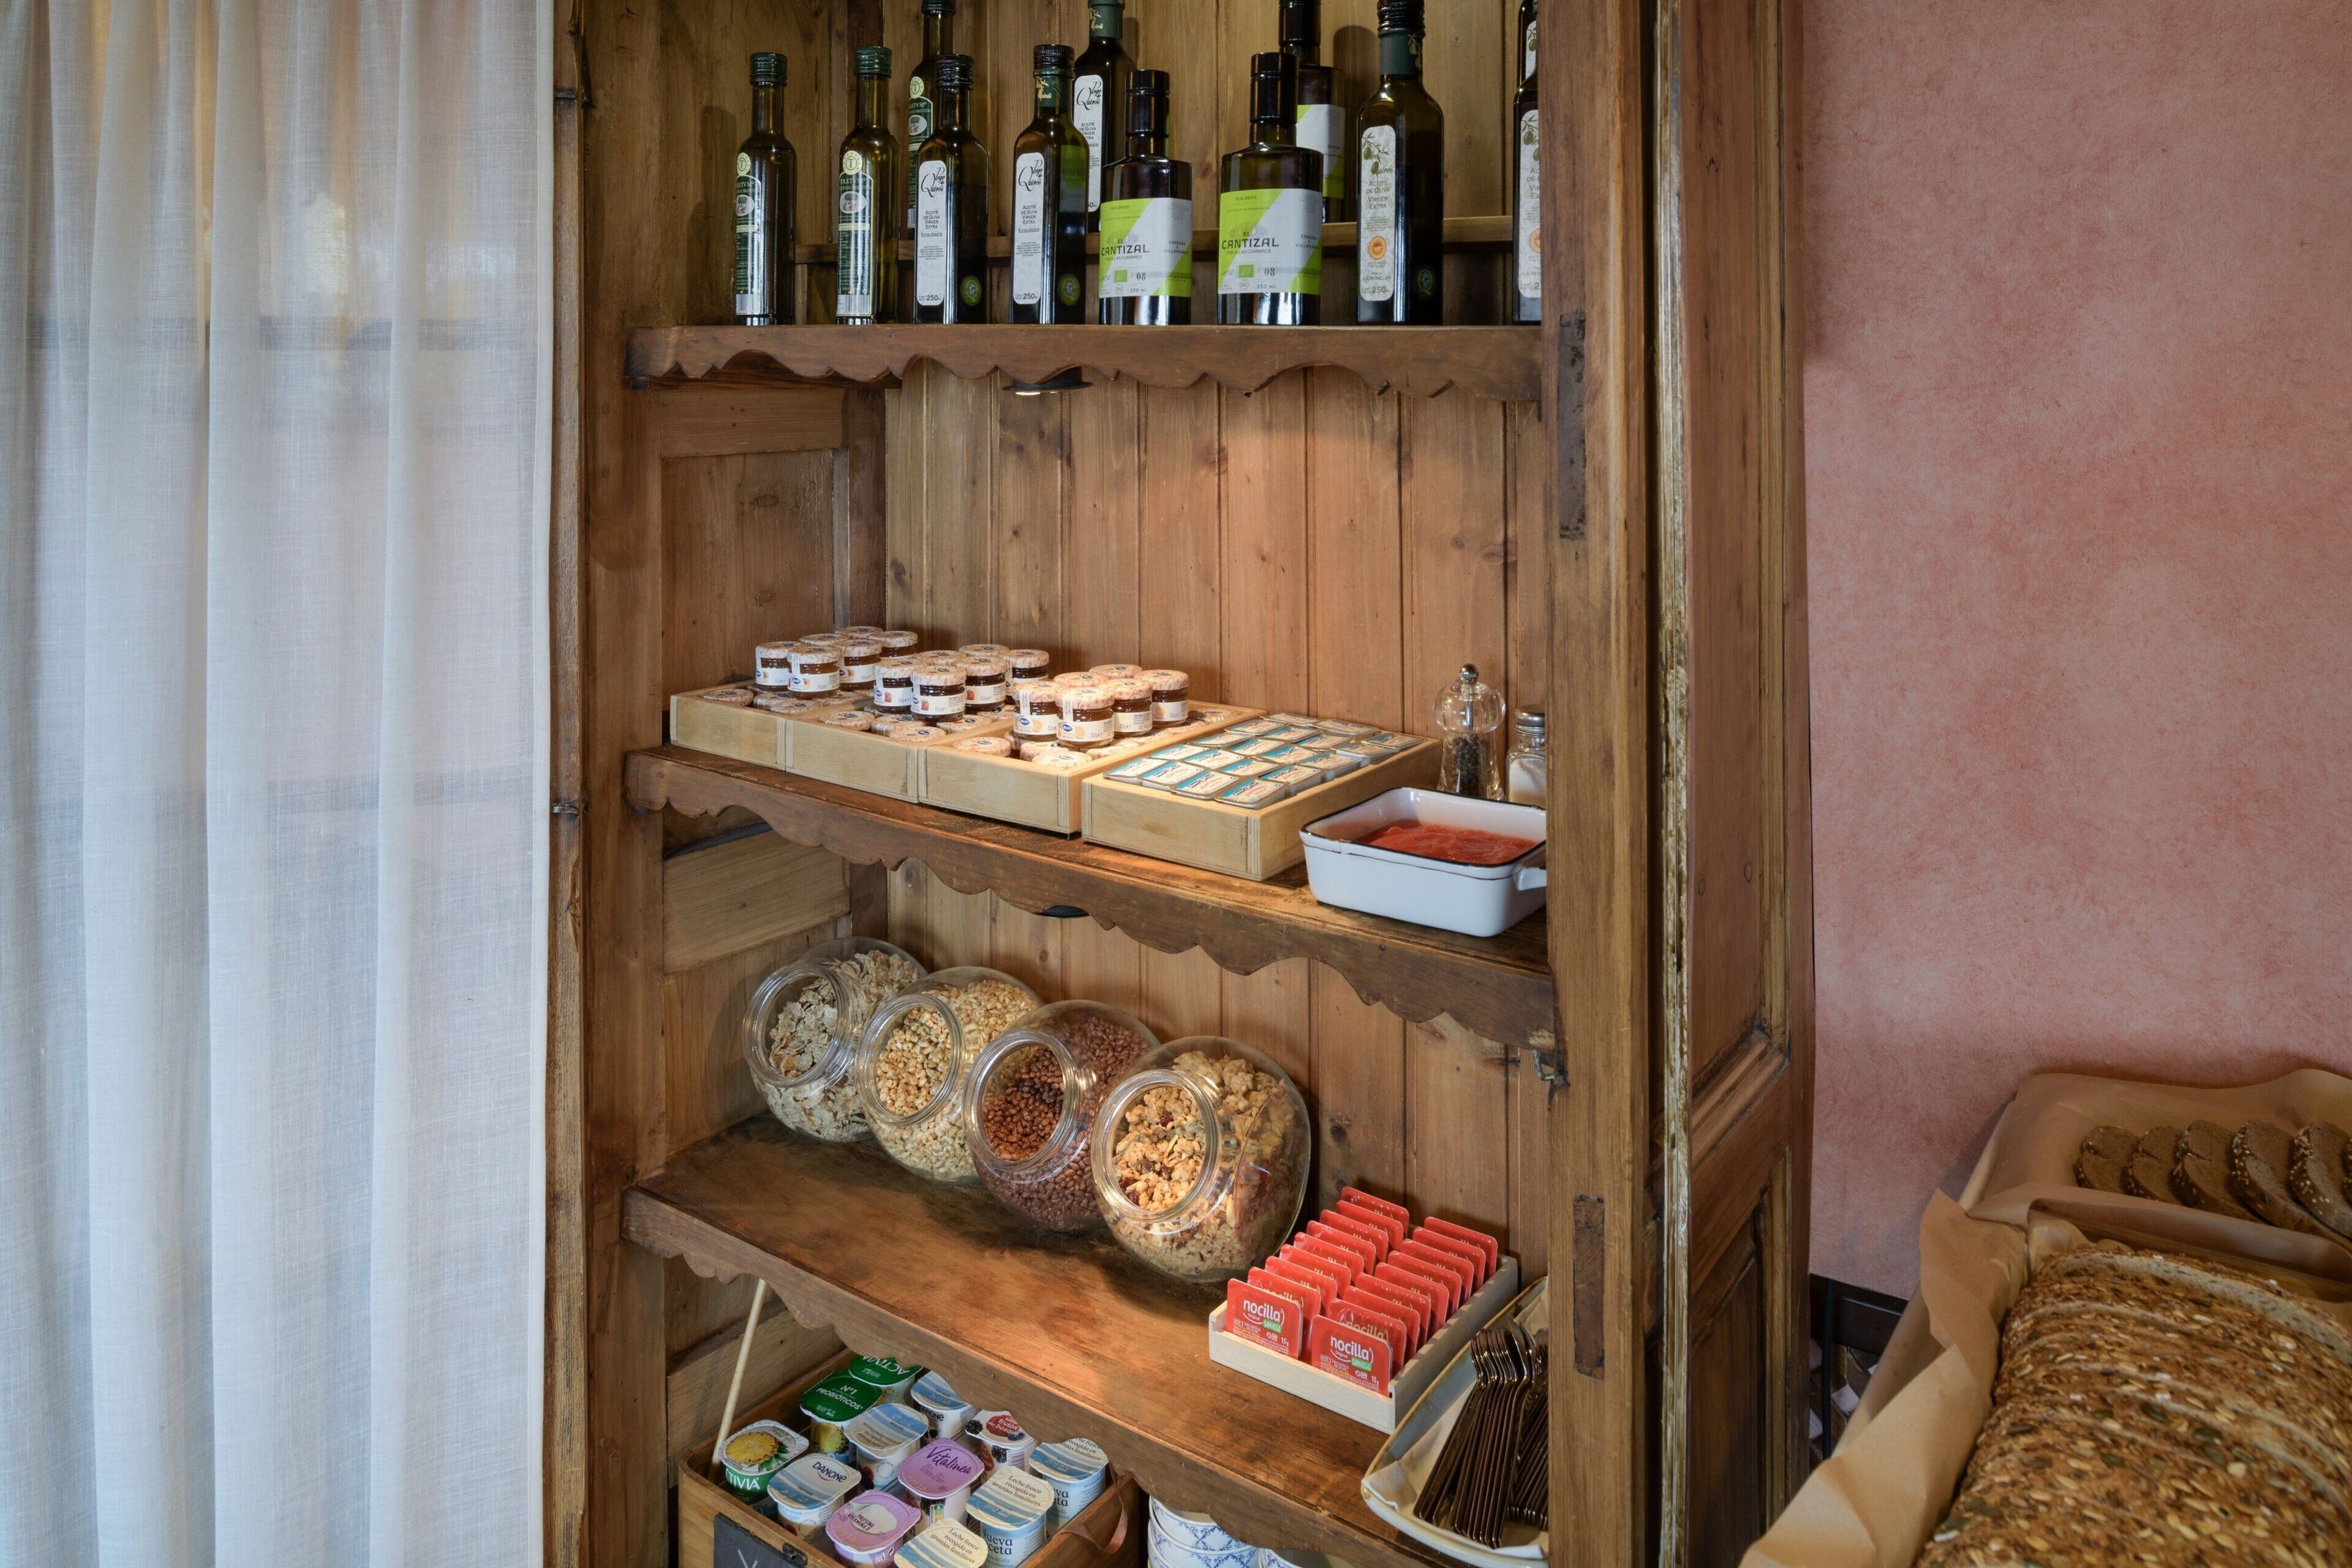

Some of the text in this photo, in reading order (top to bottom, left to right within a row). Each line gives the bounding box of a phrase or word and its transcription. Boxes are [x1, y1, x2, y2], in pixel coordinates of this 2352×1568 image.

[1101, 244, 1150, 256] CANTIZAL
[1221, 238, 1280, 249] CANTIZAL
[1243, 1299, 1281, 1323] nocilla
[1330, 1336, 1369, 1361] nocilla
[926, 1446, 972, 1474] Vitalinea
[1074, 1447, 1101, 1461] familiares
[992, 1482, 1013, 1495] granjas
[1013, 1491, 1041, 1506] familiares
[1005, 1482, 1029, 1495] recogida
[1008, 1475, 1042, 1494] Leche fresca
[930, 1534, 975, 1564] granjas familiares
[944, 1535, 966, 1551] recogida
[949, 1528, 979, 1551] Leche fresca
